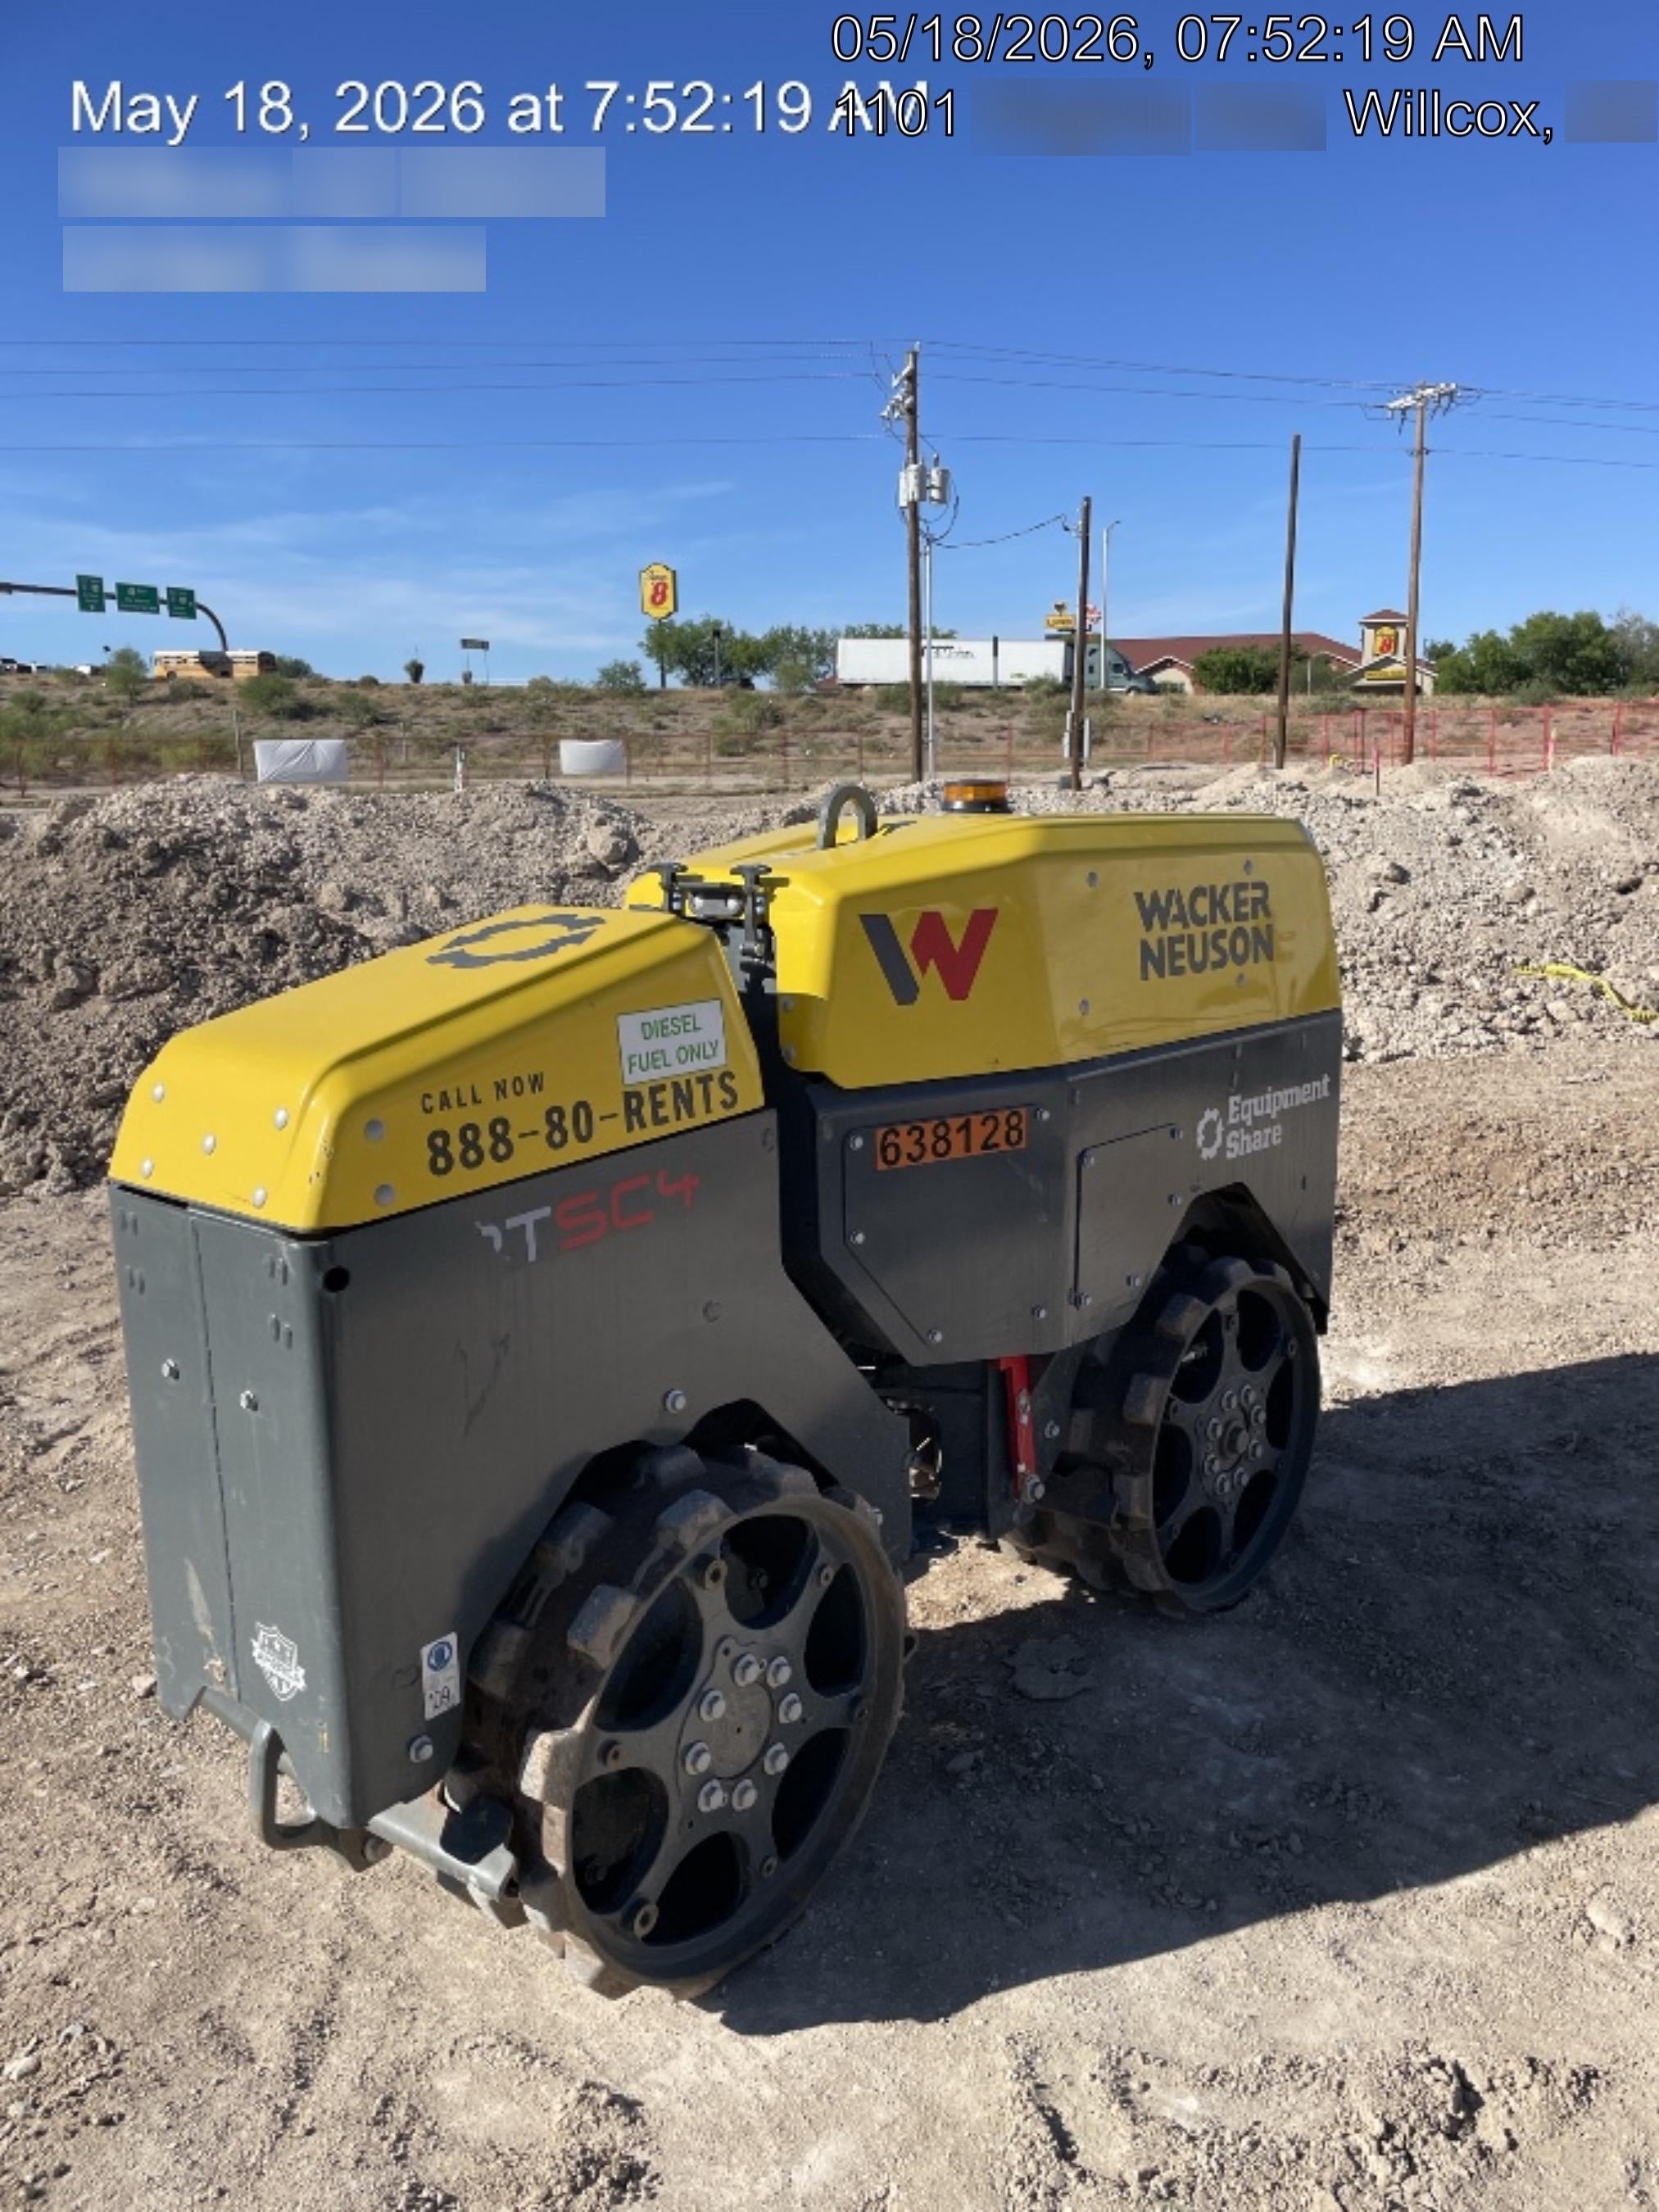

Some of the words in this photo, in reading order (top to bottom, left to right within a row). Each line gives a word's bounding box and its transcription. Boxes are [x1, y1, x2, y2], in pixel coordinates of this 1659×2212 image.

[650, 582, 669, 605] 8
[1134, 882, 1271, 932] WACKER
[1140, 923, 1274, 981] NEUSON
[641, 1013, 701, 1040] DIESEL
[628, 1051, 673, 1075] FUEL
[675, 1039, 719, 1066] ONLY
[420, 1083, 483, 1114] CALL
[495, 1071, 546, 1101] NOW
[1228, 1074, 1331, 1125] Equipment
[427, 1070, 739, 1176] 888-80-RENTS
[878, 1110, 1025, 1167] 638128
[1226, 1122, 1283, 1160] Share
